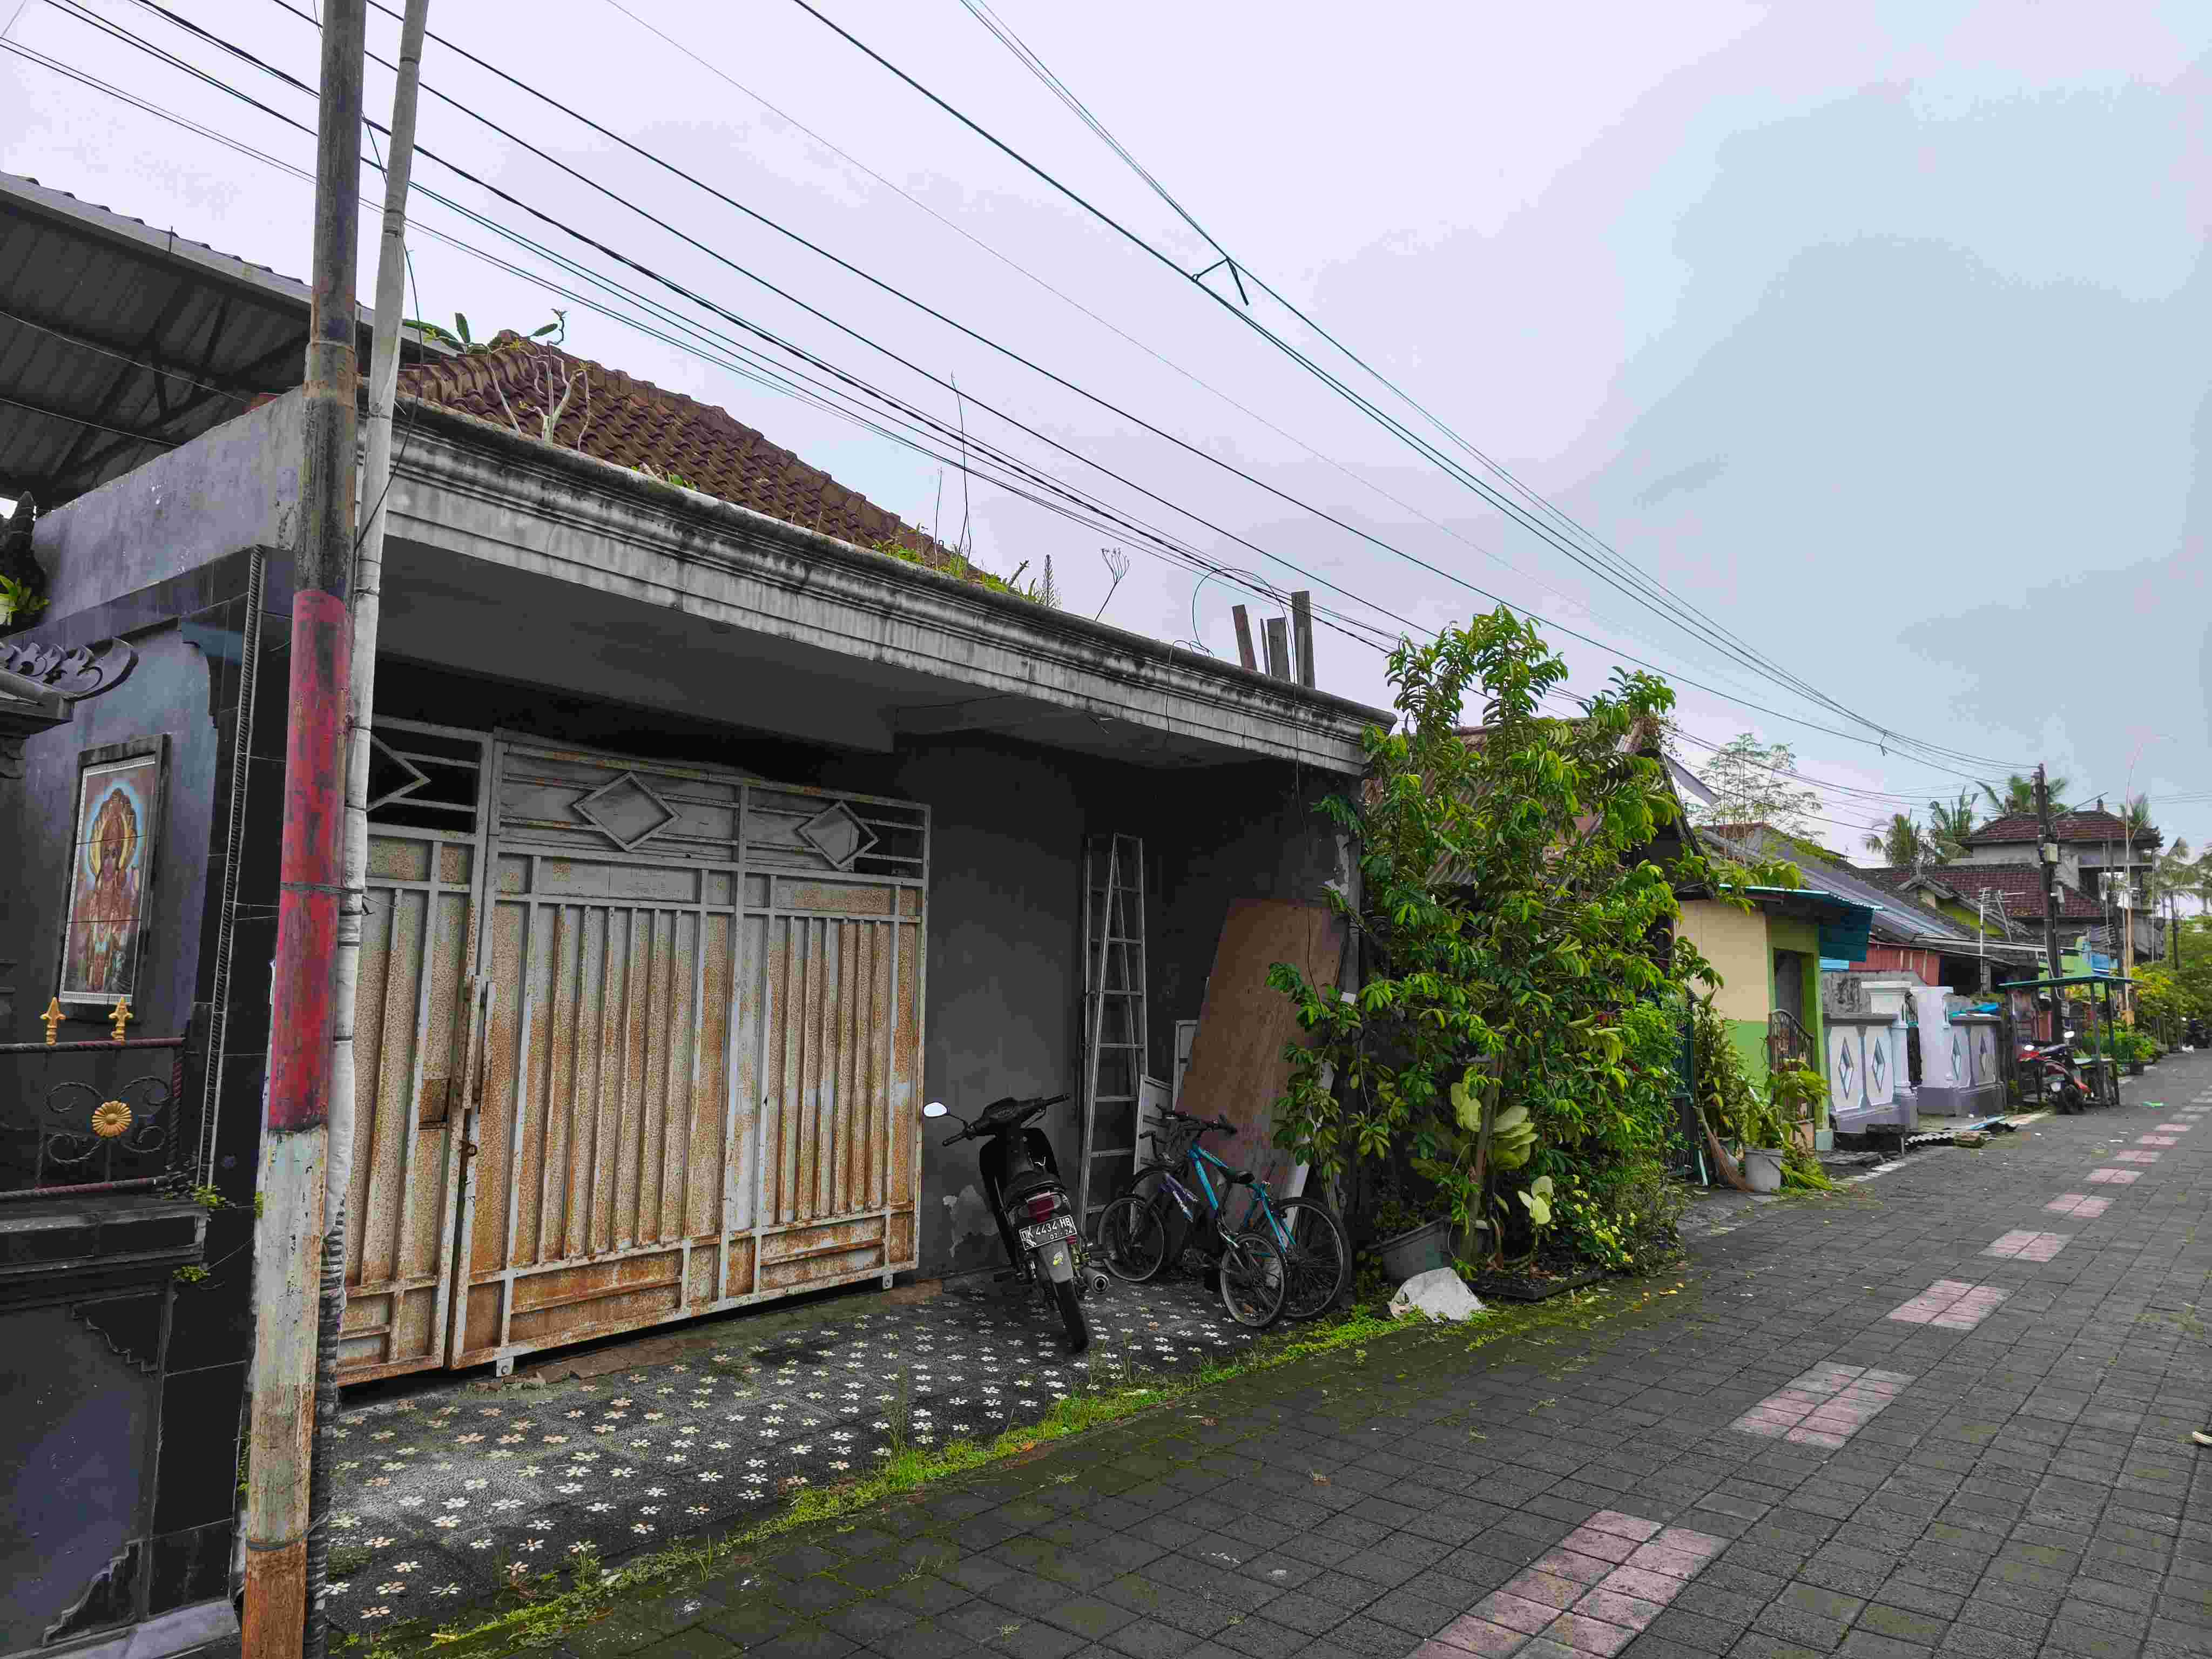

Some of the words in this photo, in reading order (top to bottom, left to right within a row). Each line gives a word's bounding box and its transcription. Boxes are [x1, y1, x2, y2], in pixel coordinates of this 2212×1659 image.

[1022, 1226, 1034, 1239] DK
[1036, 1221, 1057, 1235] 4434
[1059, 1218, 1071, 1228] HB
